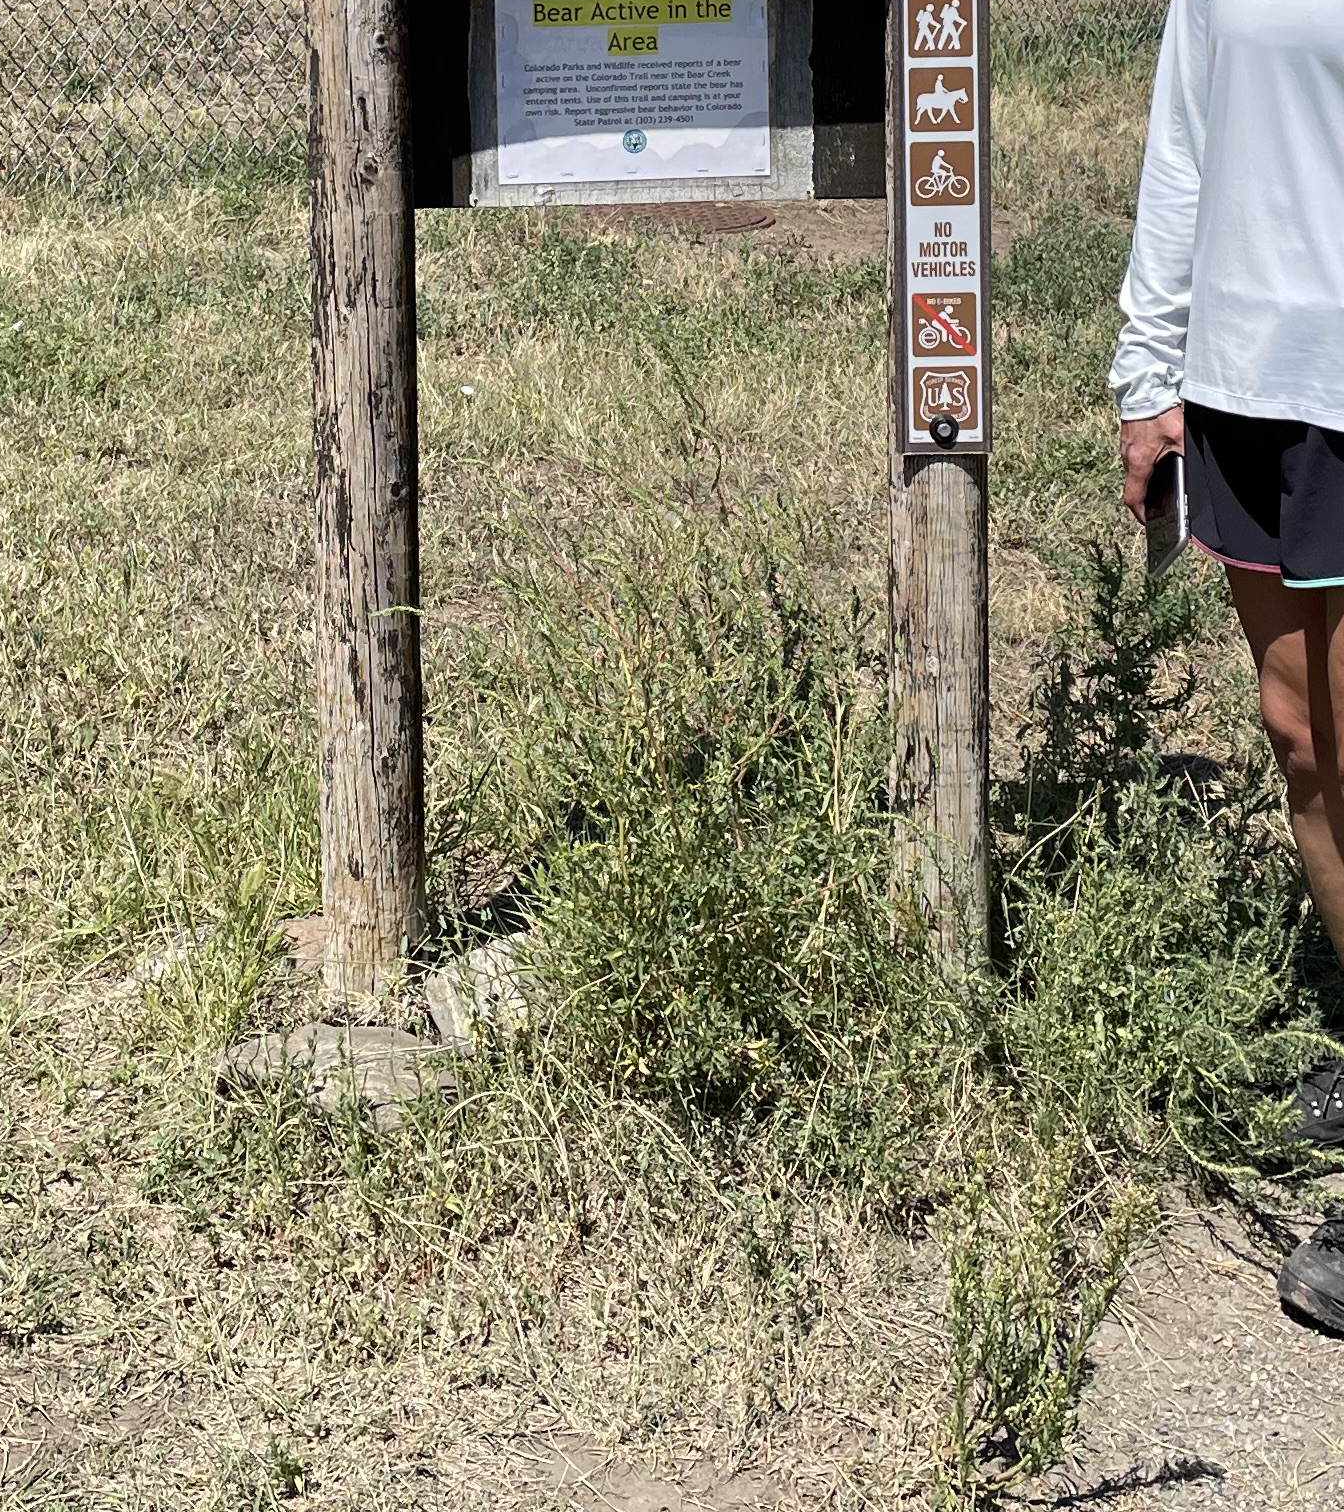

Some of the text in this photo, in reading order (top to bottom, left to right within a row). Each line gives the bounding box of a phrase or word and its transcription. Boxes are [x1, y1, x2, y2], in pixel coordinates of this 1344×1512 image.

[533, 0, 731, 22] Bear Active in the
[608, 32, 658, 51] Area
[524, 64, 560, 72] Colorado
[586, 62, 601, 70] and
[675, 60, 703, 69] reports
[706, 59, 714, 67] of
[591, 73, 627, 81] Colorado
[630, 72, 648, 80] Trail
[523, 87, 557, 95] camping
[586, 84, 637, 92] Unconfirmed
[640, 83, 668, 92] reports
[526, 97, 558, 105] entered
[604, 95, 612, 103] of
[668, 93, 701, 102] camping
[723, 92, 741, 100] your
[565, 108, 592, 117] Report
[594, 106, 635, 116] aggressive
[706, 103, 742, 111] Colorado
[574, 118, 595, 126] State
[934, 221, 952, 238] NO
[919, 240, 968, 258] MOTOR
[911, 260, 976, 278] VEHICLES
